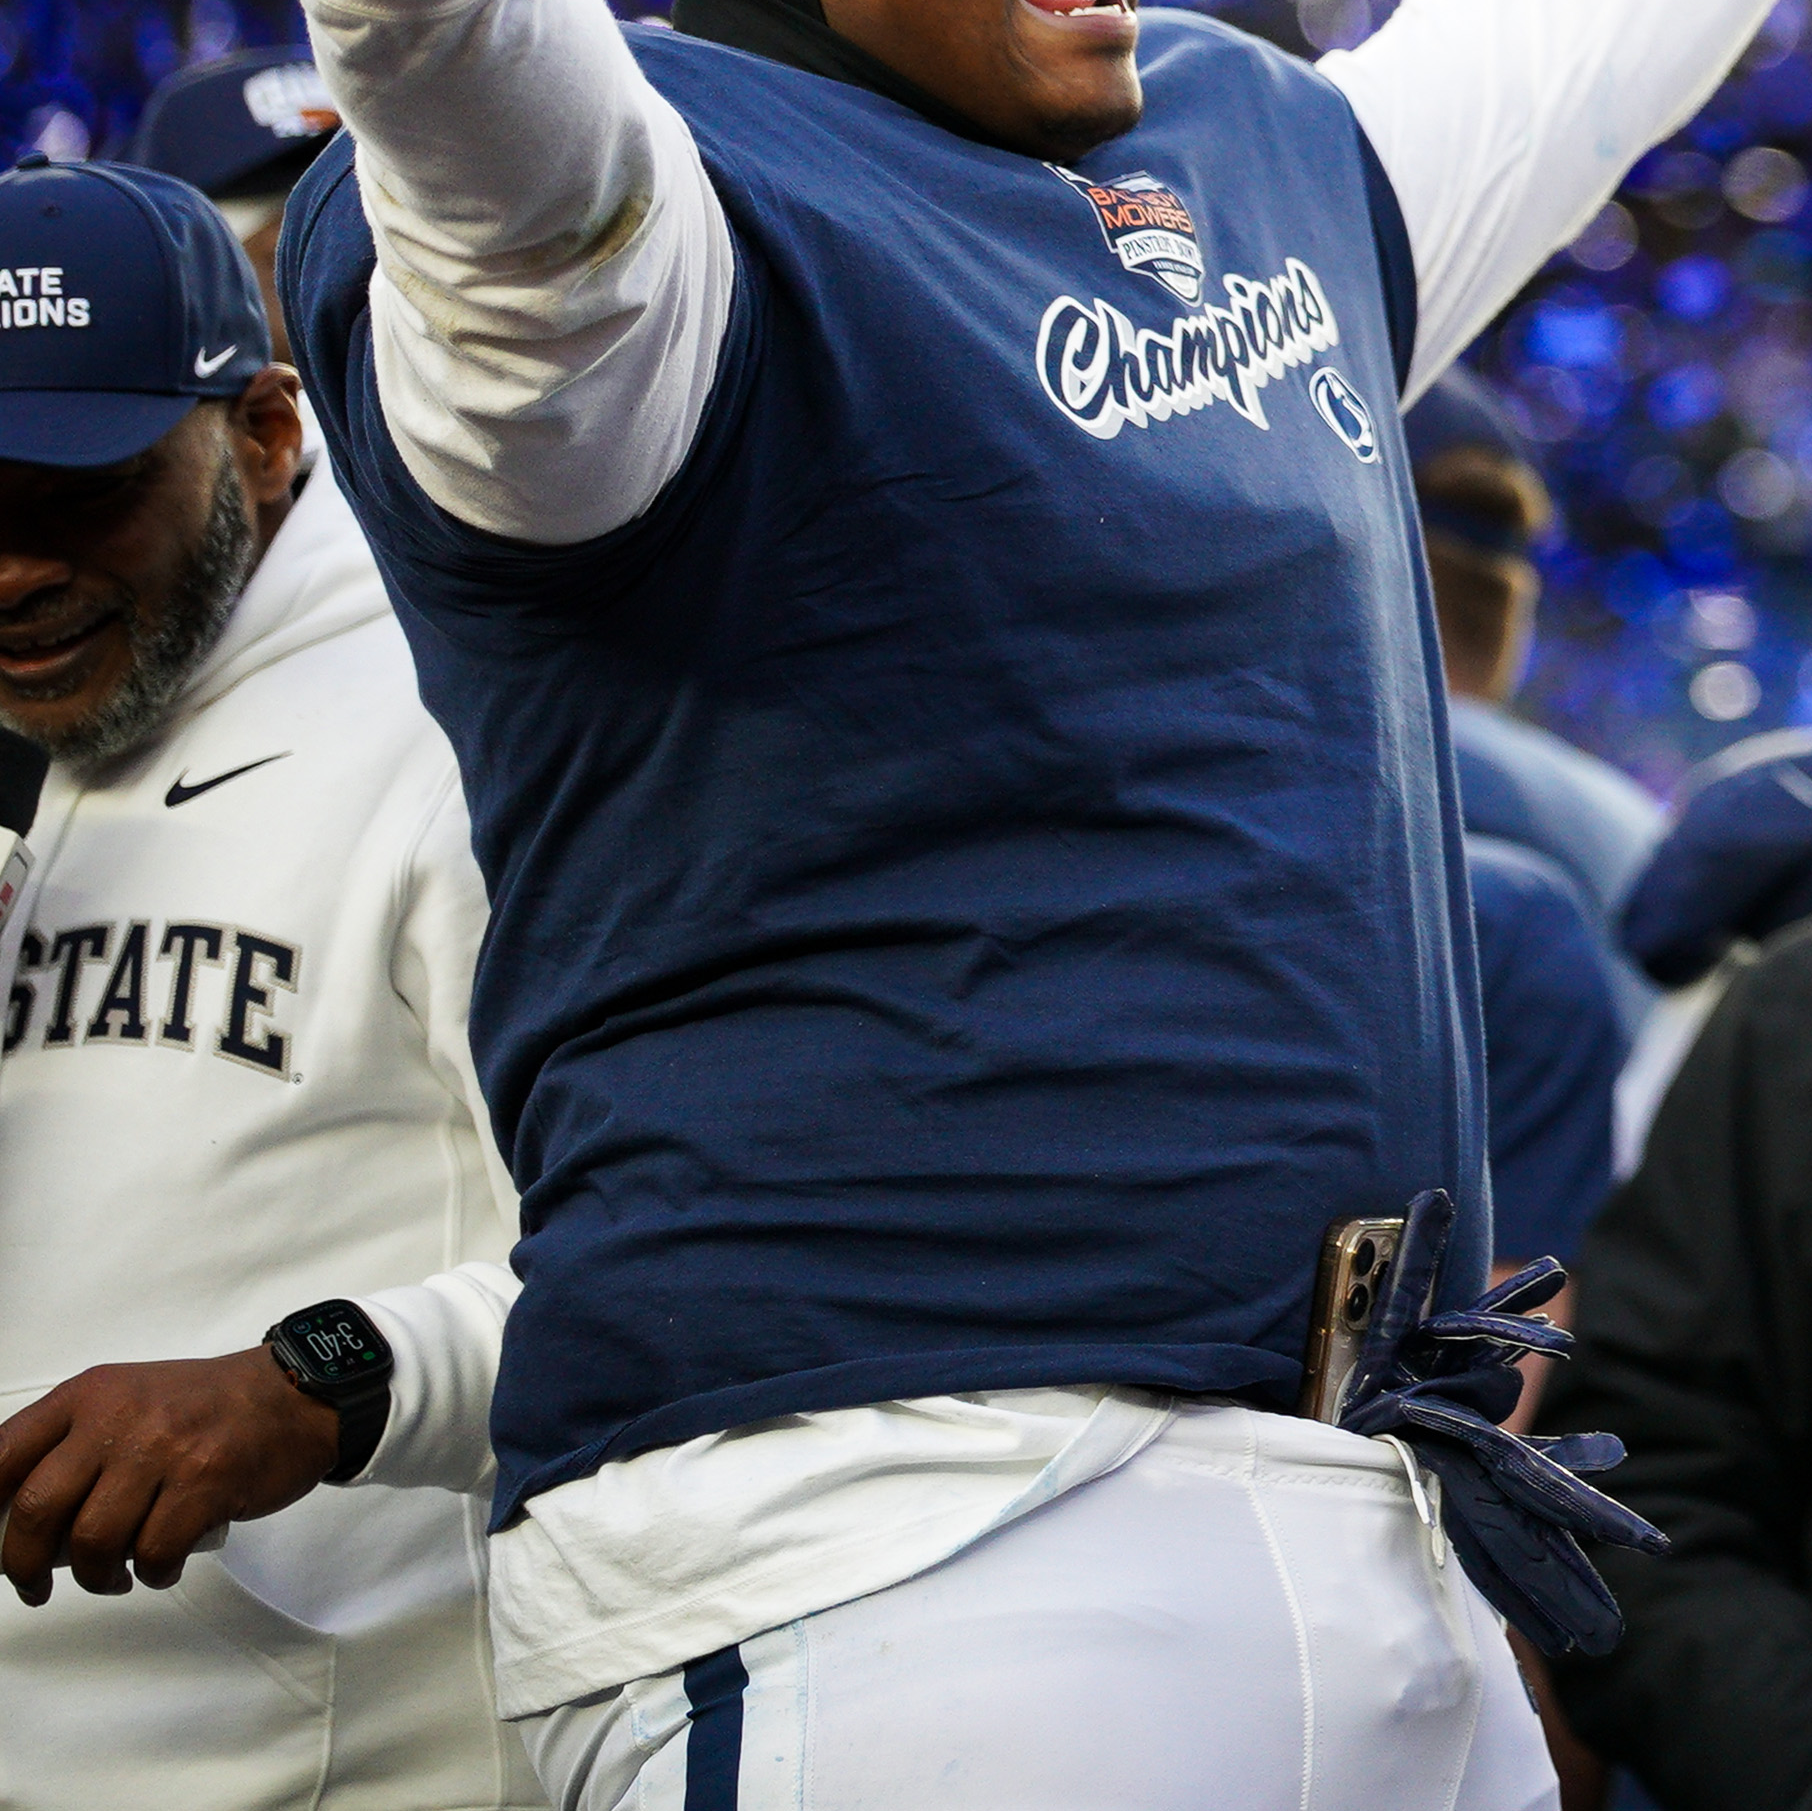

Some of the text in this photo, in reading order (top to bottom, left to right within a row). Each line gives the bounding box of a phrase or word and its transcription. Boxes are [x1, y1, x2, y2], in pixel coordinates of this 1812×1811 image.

[1101, 204, 1193, 233] MOWERS
[1036, 256, 1340, 439] Champions
[307, 1322, 363, 1361] 3:40
